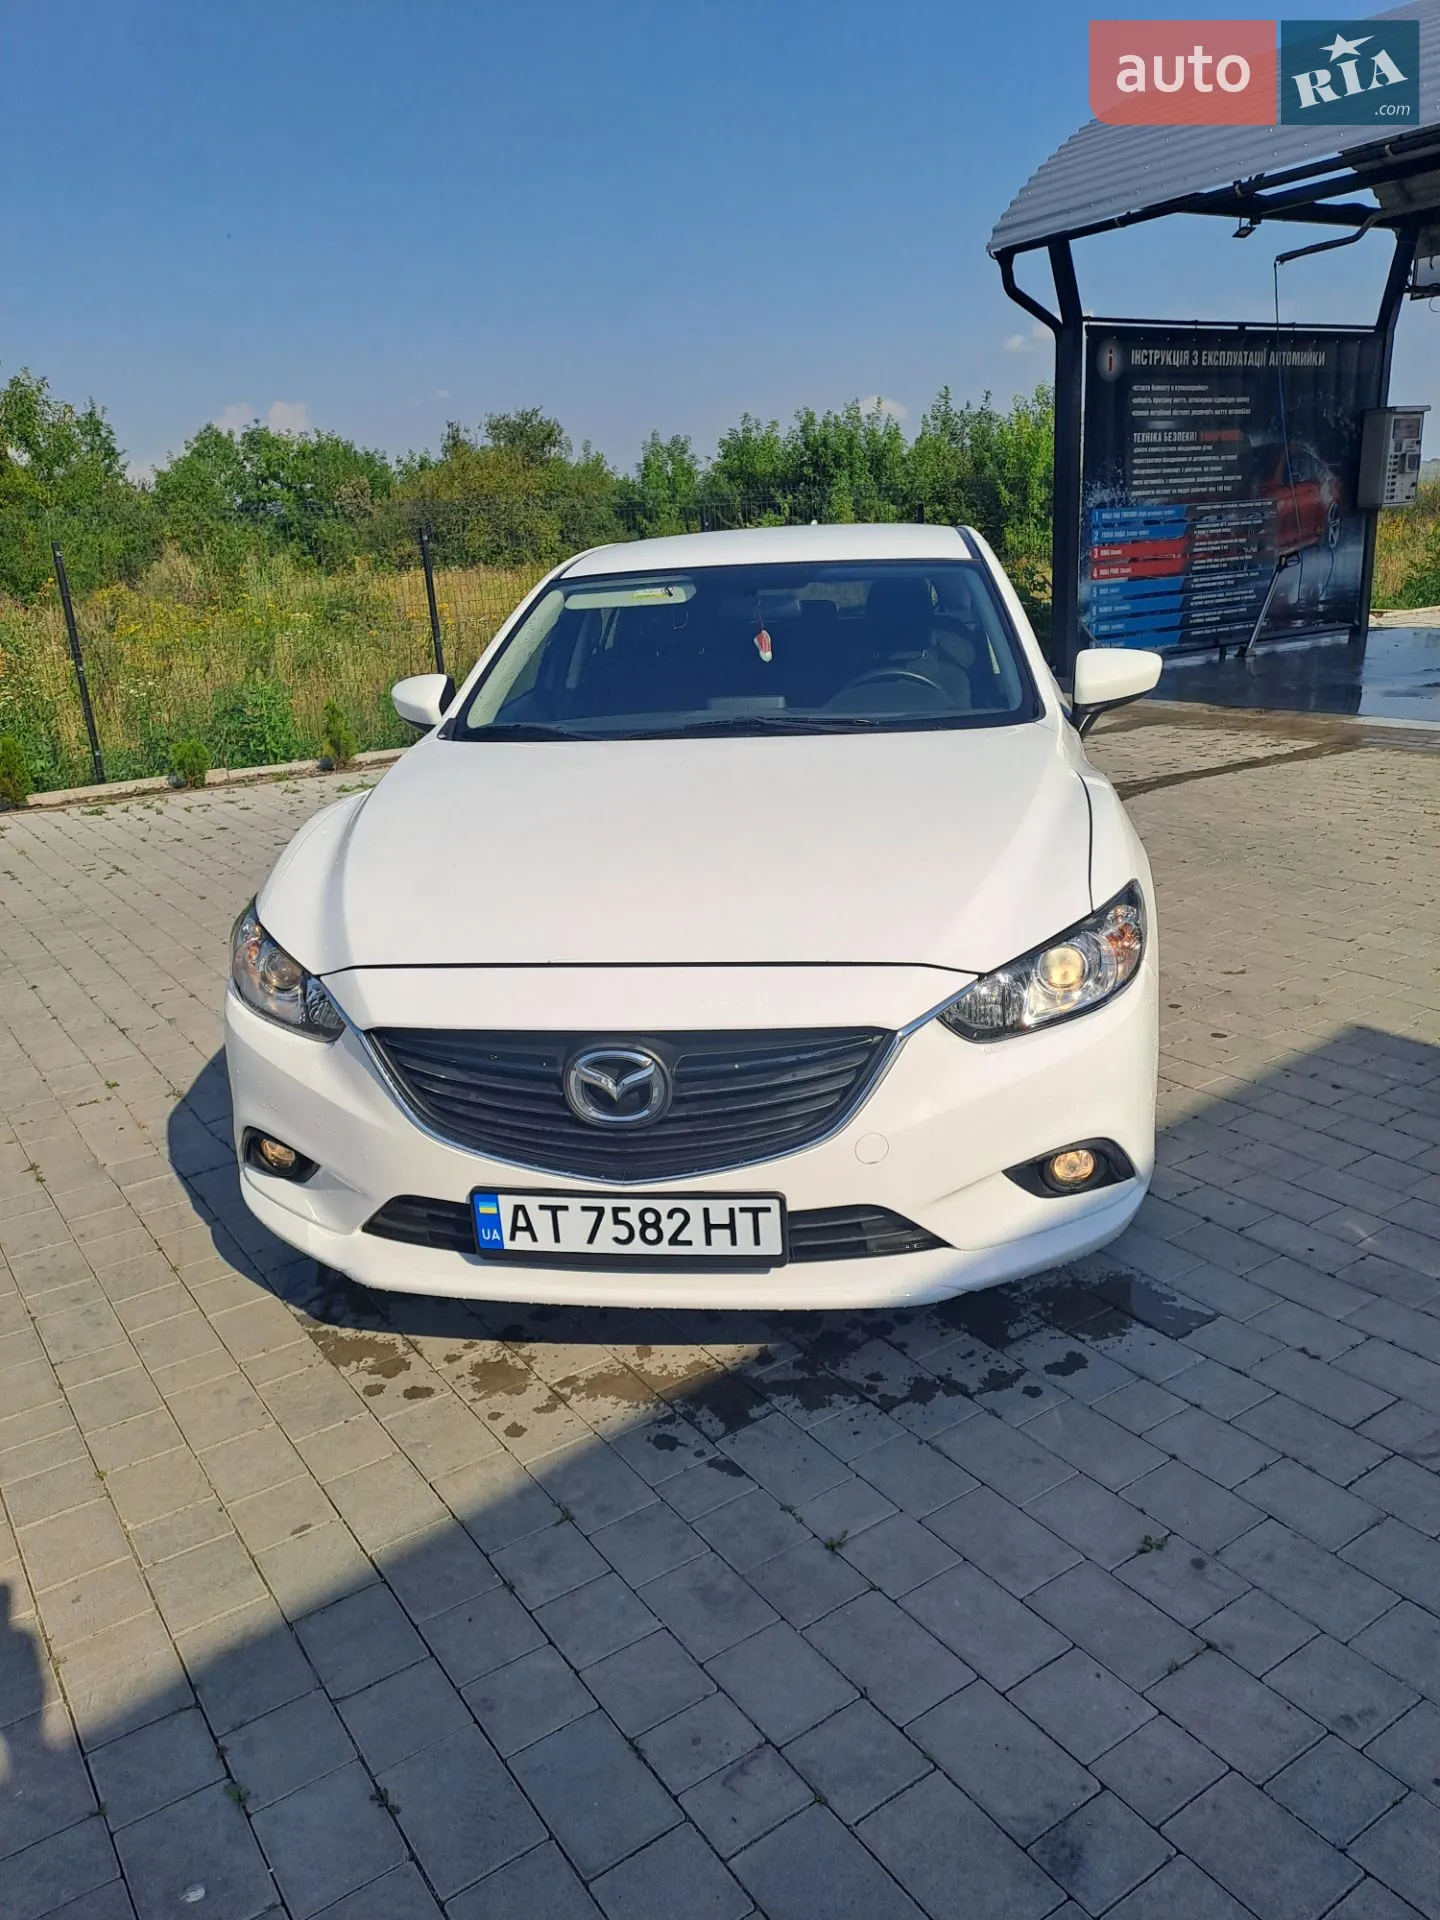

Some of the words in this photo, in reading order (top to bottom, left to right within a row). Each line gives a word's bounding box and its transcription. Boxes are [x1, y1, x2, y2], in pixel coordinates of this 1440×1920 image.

[1131, 348, 1190, 368] ІНСТРУКЦІЯ
[1201, 348, 1267, 368] ЕКСПЛУАТАЦІЇ
[1133, 432, 1162, 443] ТЕХНІКА
[509, 1204, 569, 1244] AT
[581, 1205, 693, 1247] 7582
[703, 1206, 772, 1247] HT
[481, 1229, 501, 1241] UA
